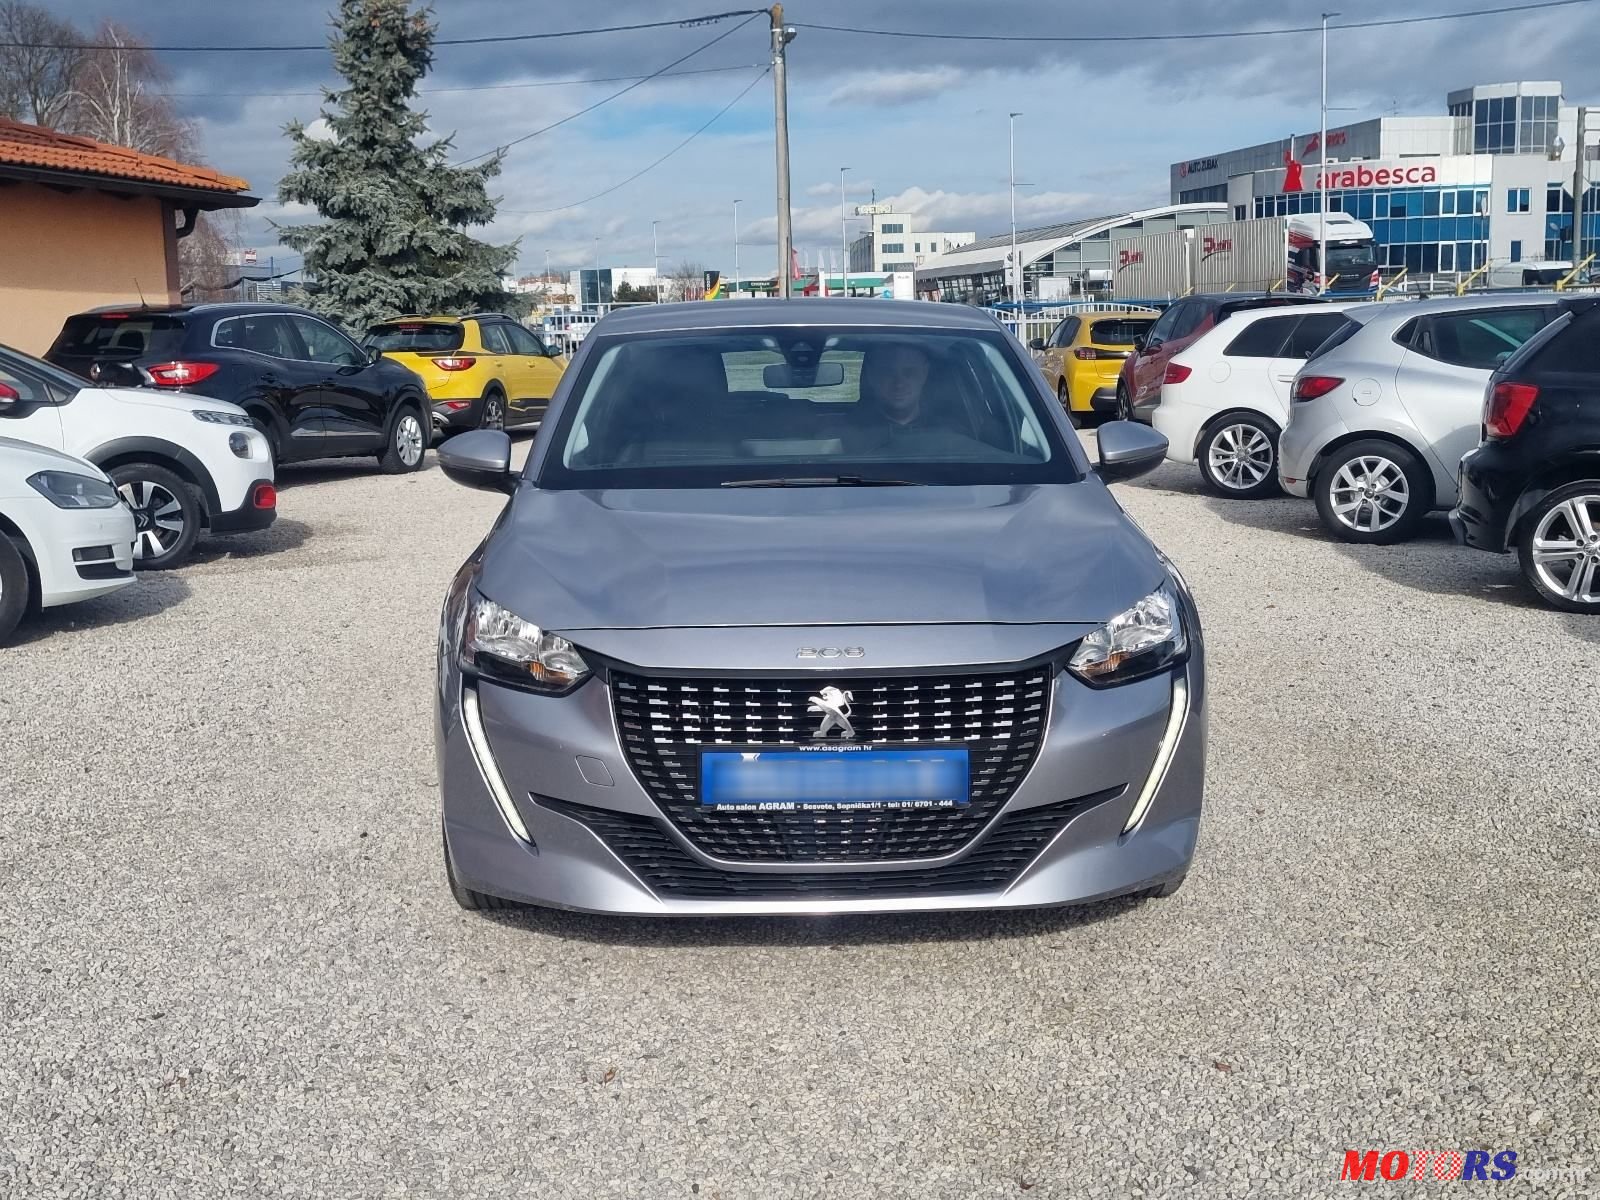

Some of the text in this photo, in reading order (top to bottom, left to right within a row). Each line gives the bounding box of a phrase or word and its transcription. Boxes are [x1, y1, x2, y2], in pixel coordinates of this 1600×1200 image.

[1316, 165, 1435, 190] arabesca
[796, 646, 866, 658] 208
[717, 803, 734, 811] Auto
[736, 803, 757, 811] salon
[759, 802, 795, 811] AGRAM
